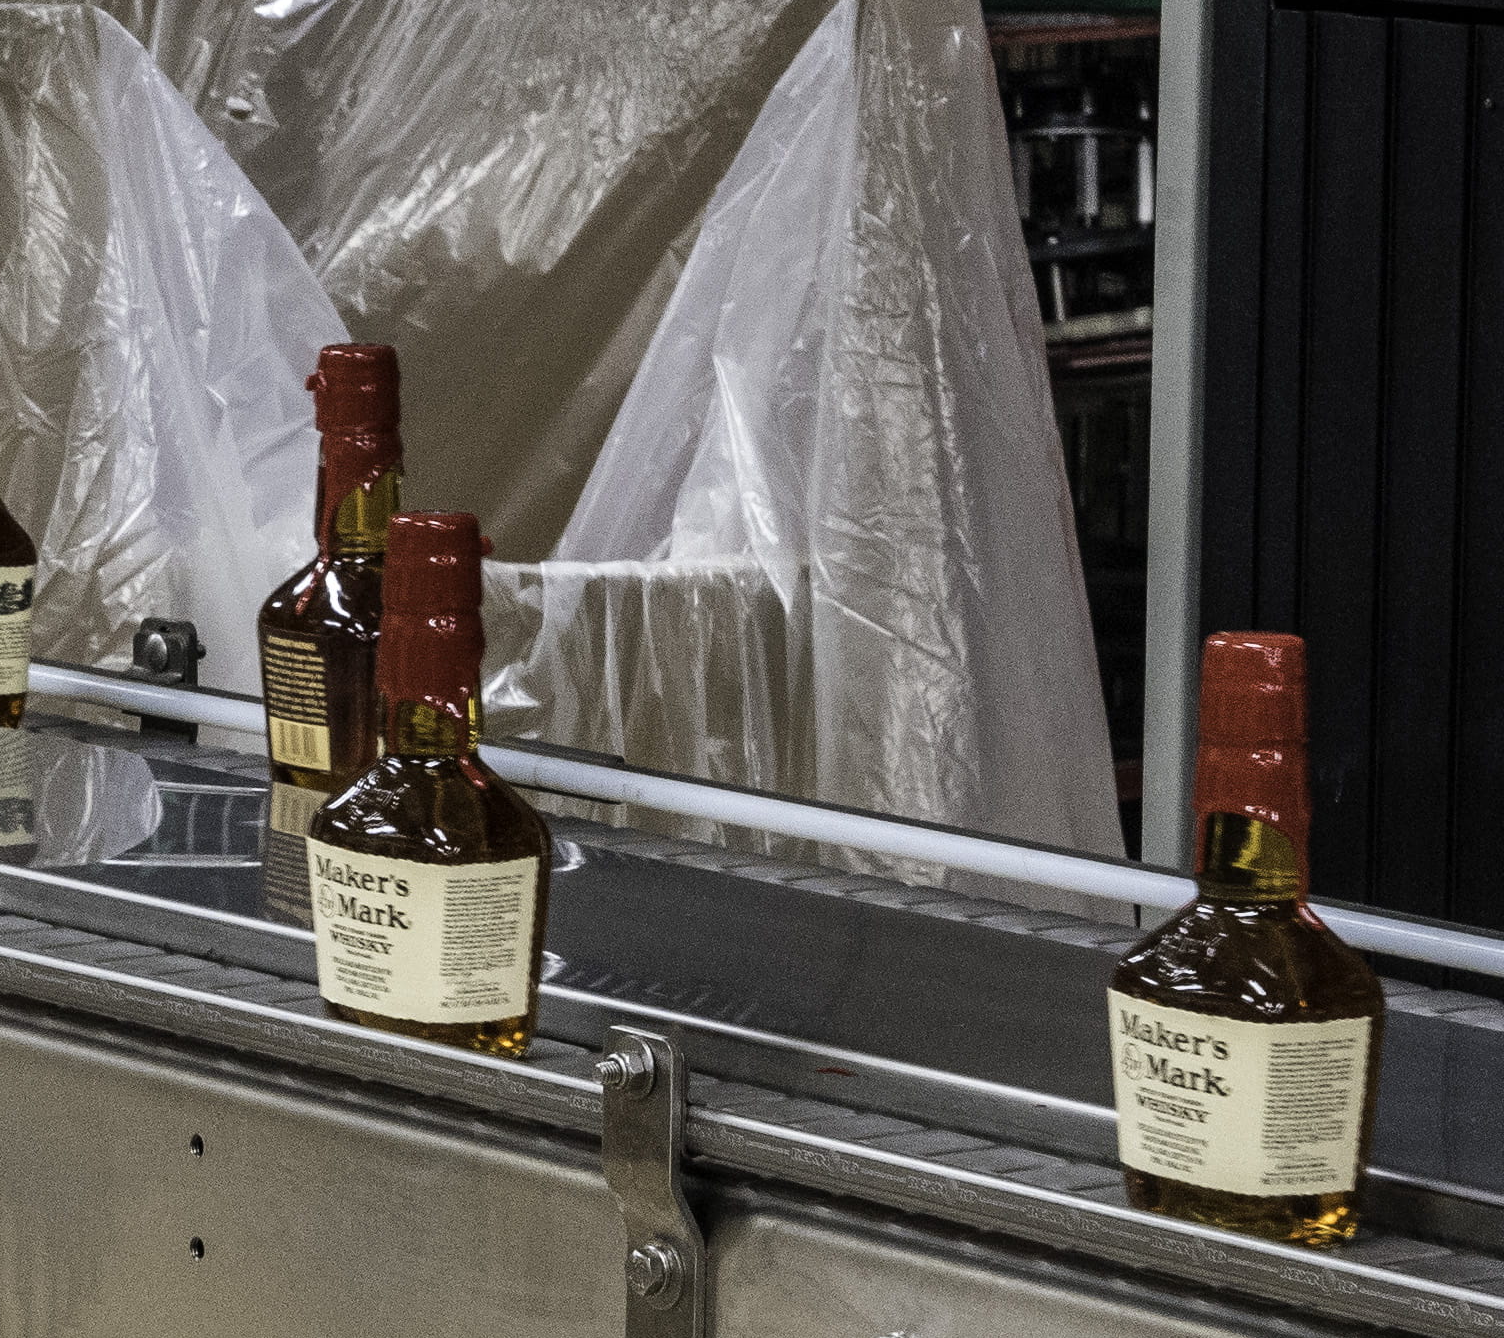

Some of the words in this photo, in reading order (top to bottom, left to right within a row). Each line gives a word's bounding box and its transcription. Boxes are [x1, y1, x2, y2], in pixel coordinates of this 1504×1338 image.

[314, 854, 411, 898] Maker's
[337, 892, 412, 930] Mark
[328, 929, 395, 955] WHISKY
[1119, 1009, 1231, 1062] Maker's
[1144, 1053, 1231, 1098] Mark
